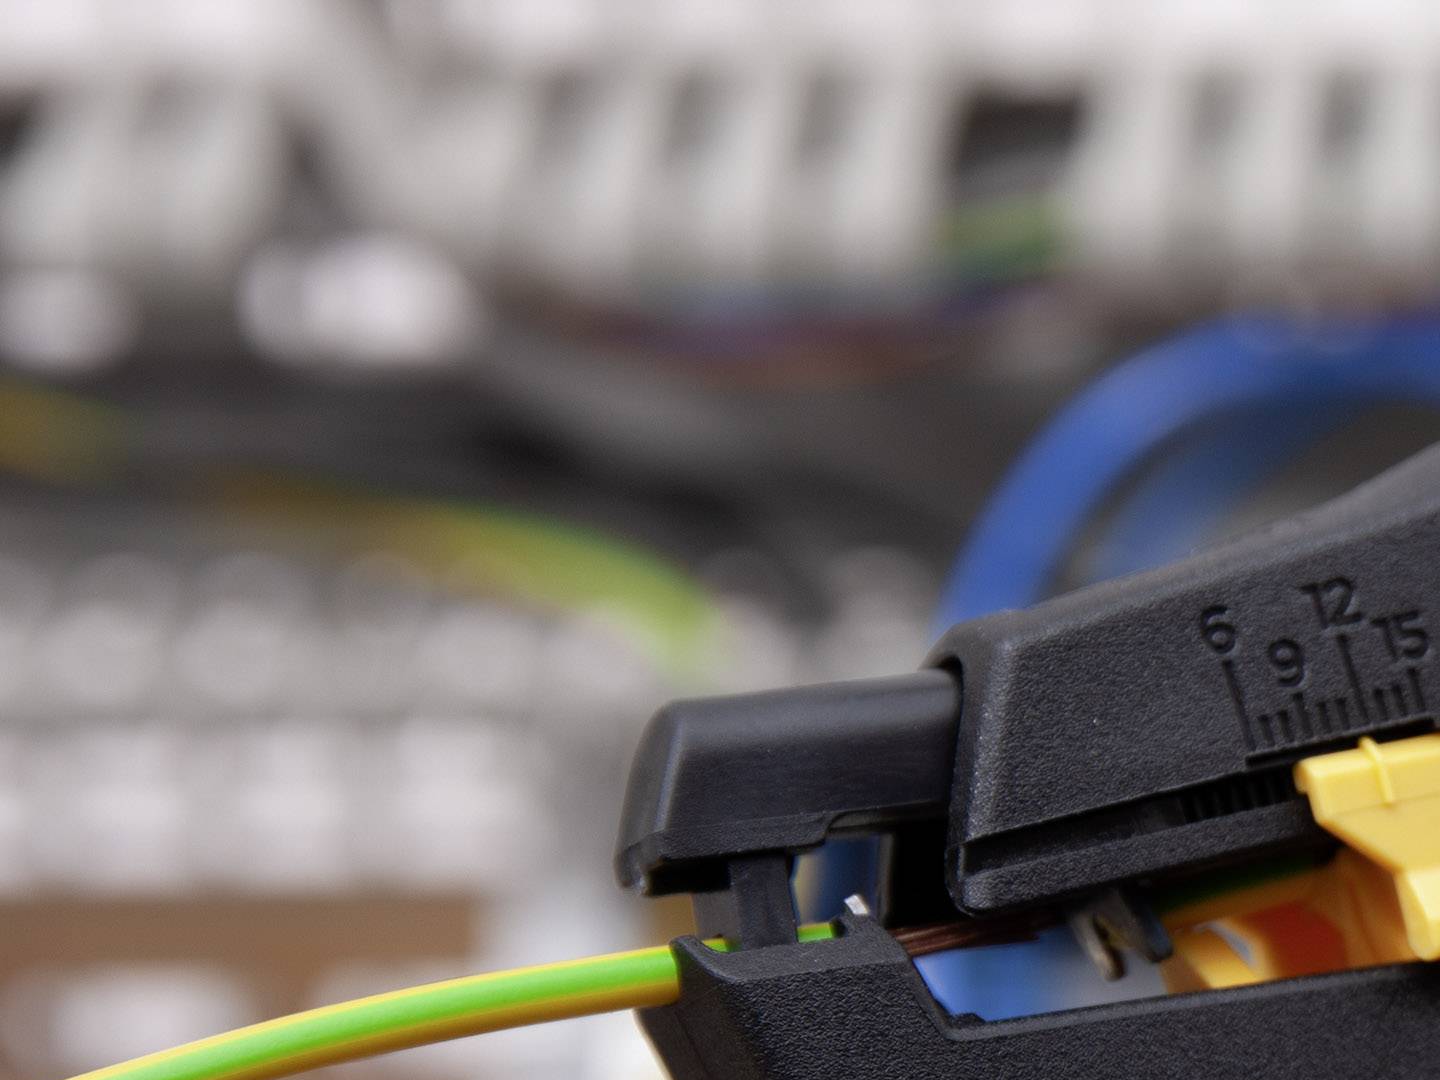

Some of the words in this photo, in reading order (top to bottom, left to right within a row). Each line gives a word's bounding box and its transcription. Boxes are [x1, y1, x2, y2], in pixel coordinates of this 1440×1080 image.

[1301, 577, 1362, 629] 12
[1200, 604, 1236, 654] 6
[1372, 610, 1430, 659] 15
[1267, 638, 1306, 687] 9
